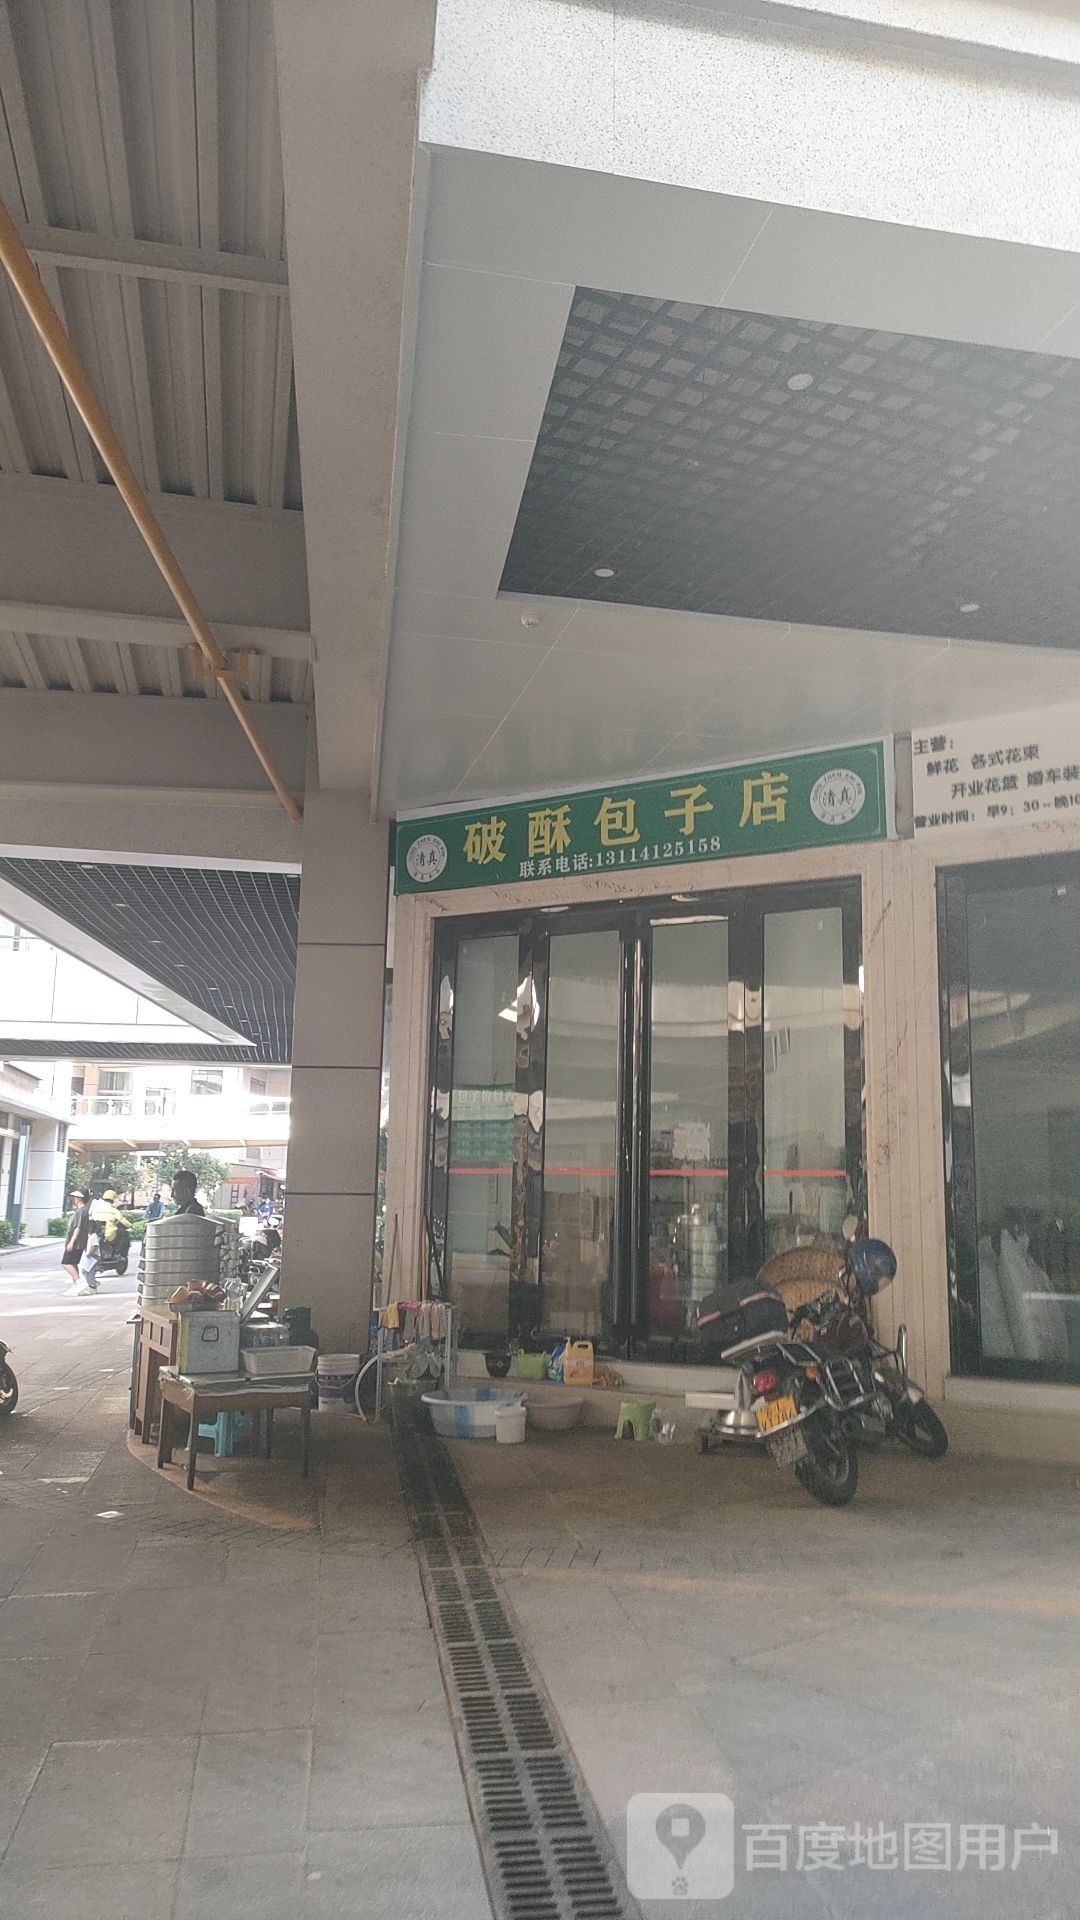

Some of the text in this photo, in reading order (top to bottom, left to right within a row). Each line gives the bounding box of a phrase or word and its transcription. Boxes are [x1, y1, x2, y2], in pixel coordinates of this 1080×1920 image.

[927, 744, 1039, 776] 鲜花 各式花束
[951, 775, 1018, 799] 开业花篮
[463, 771, 789, 865] 破酥包子店
